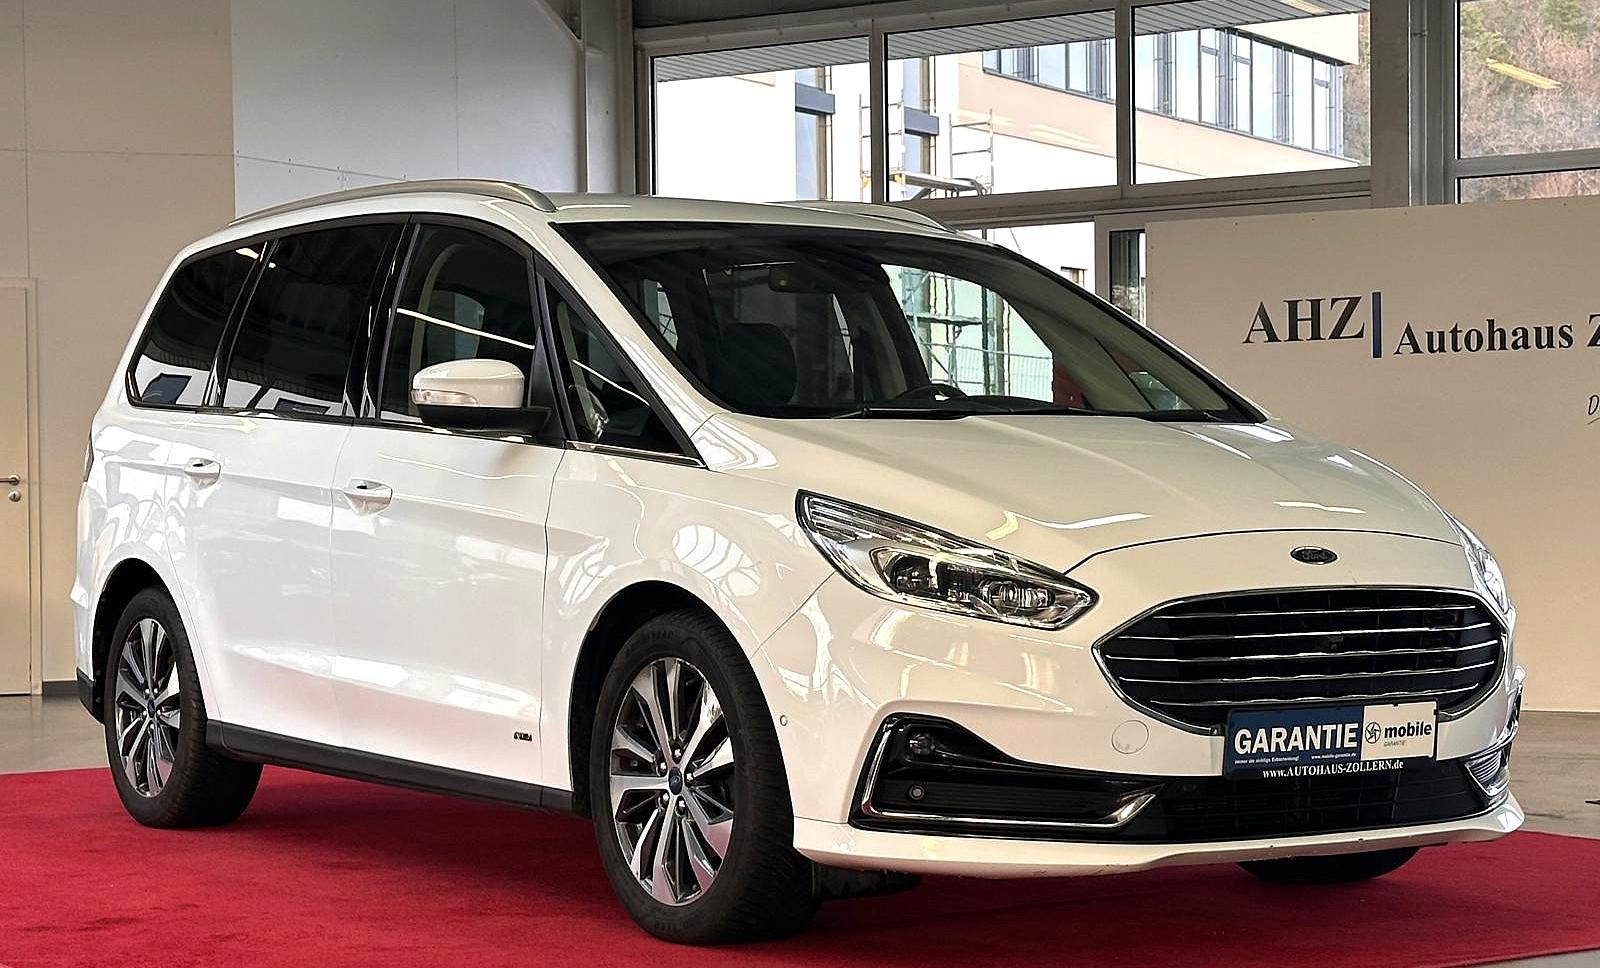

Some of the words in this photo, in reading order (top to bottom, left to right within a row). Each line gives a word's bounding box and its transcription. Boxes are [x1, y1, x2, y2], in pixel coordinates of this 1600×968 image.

[1243, 296, 1365, 344] AHZ
[1394, 319, 1574, 355] Autohaus
[1234, 723, 1359, 754] GARANTIE
[1384, 721, 1432, 738] mobile
[1262, 760, 1404, 778] www.AUTOHAUS-ZOLLERN.de
